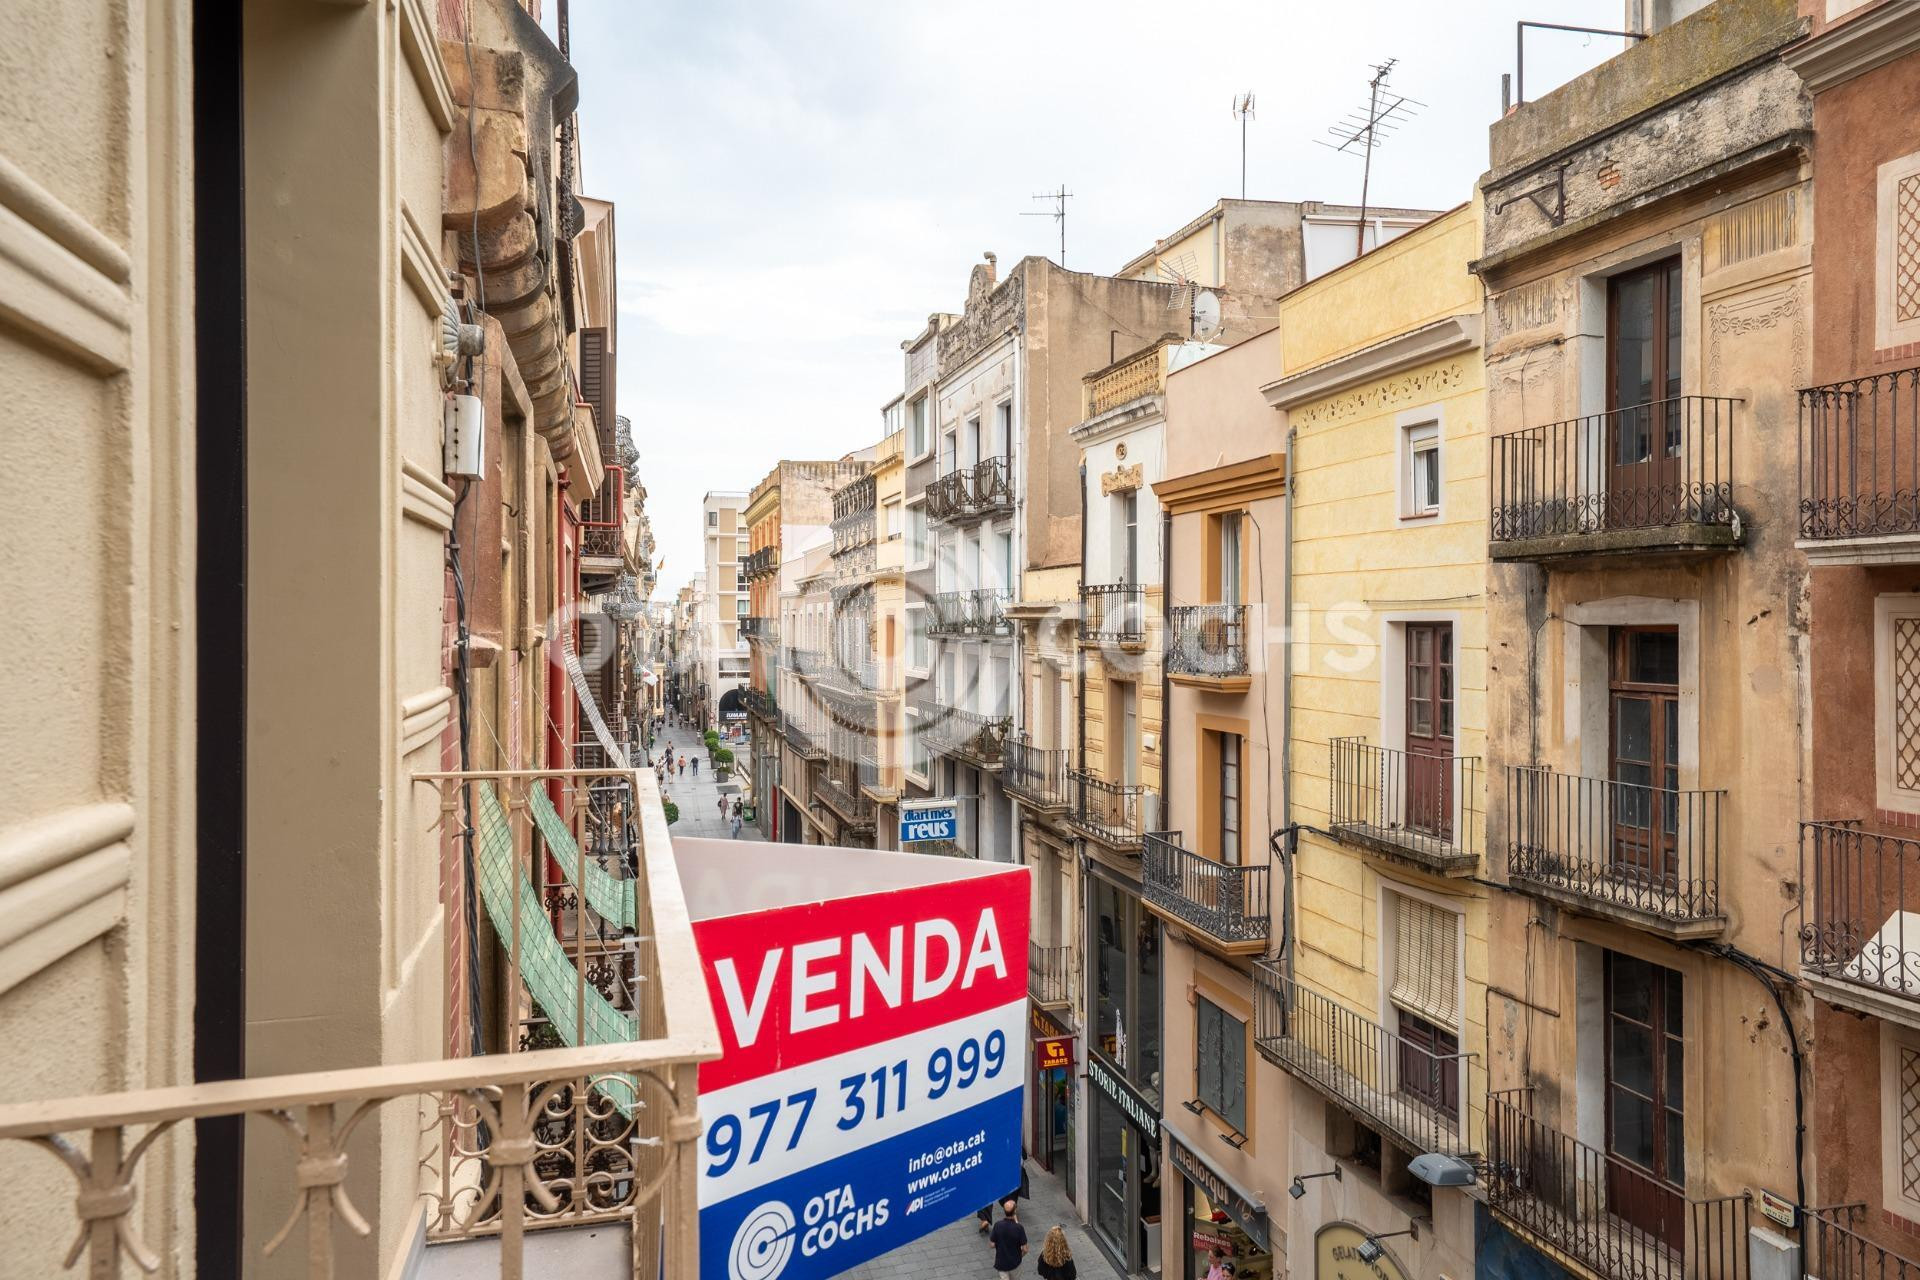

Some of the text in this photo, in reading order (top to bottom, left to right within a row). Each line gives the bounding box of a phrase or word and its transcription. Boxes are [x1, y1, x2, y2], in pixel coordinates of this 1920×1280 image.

[908, 821, 949, 840] reus
[713, 907, 1008, 1049] VENDA
[705, 1028, 1006, 1178] 977 311 999
[1088, 1059, 1157, 1139] STORIE ITALIANE
[907, 1150, 983, 1195] www.ota.cat
[908, 1129, 986, 1174] info@ota.cat
[803, 1183, 856, 1226] OTA
[801, 1198, 890, 1257] COCHS
[1193, 1230, 1232, 1248] Rebaixes
